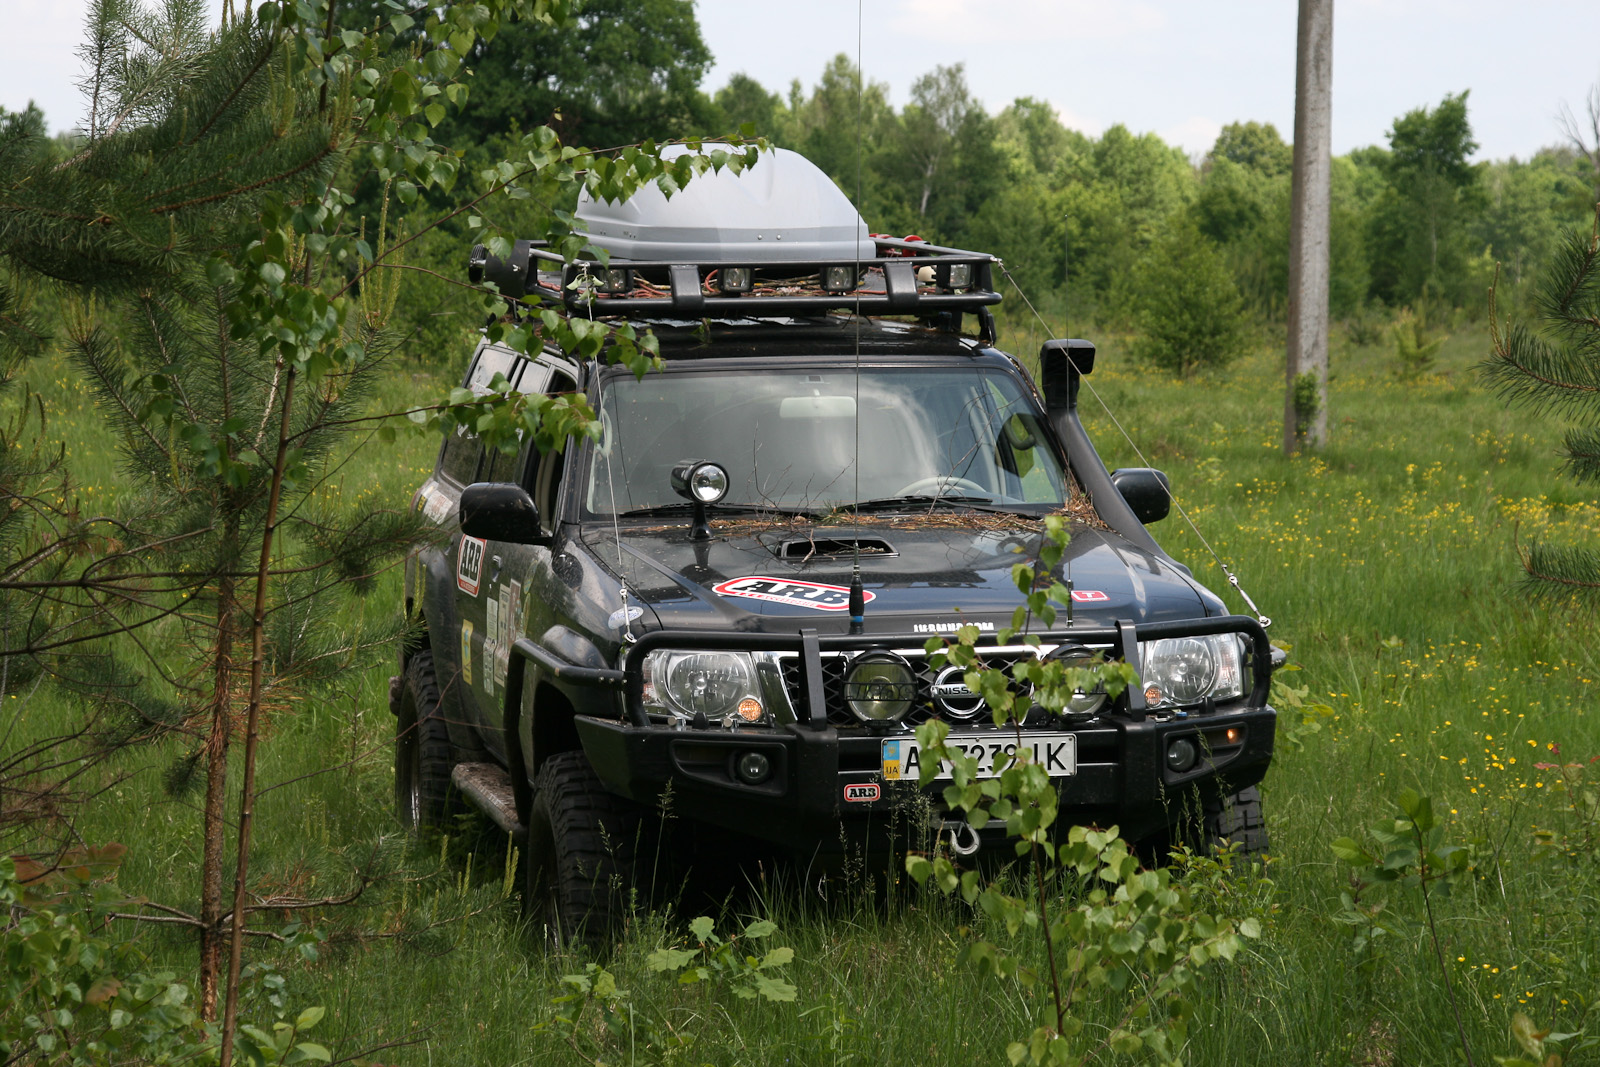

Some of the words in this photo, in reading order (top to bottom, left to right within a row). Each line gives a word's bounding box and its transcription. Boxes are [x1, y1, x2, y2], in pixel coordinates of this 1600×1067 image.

[459, 538, 482, 582] ARB
[731, 581, 850, 605] ARB
[886, 766, 899, 774] UA
[904, 746, 945, 774] A
[849, 788, 876, 798] ARB
